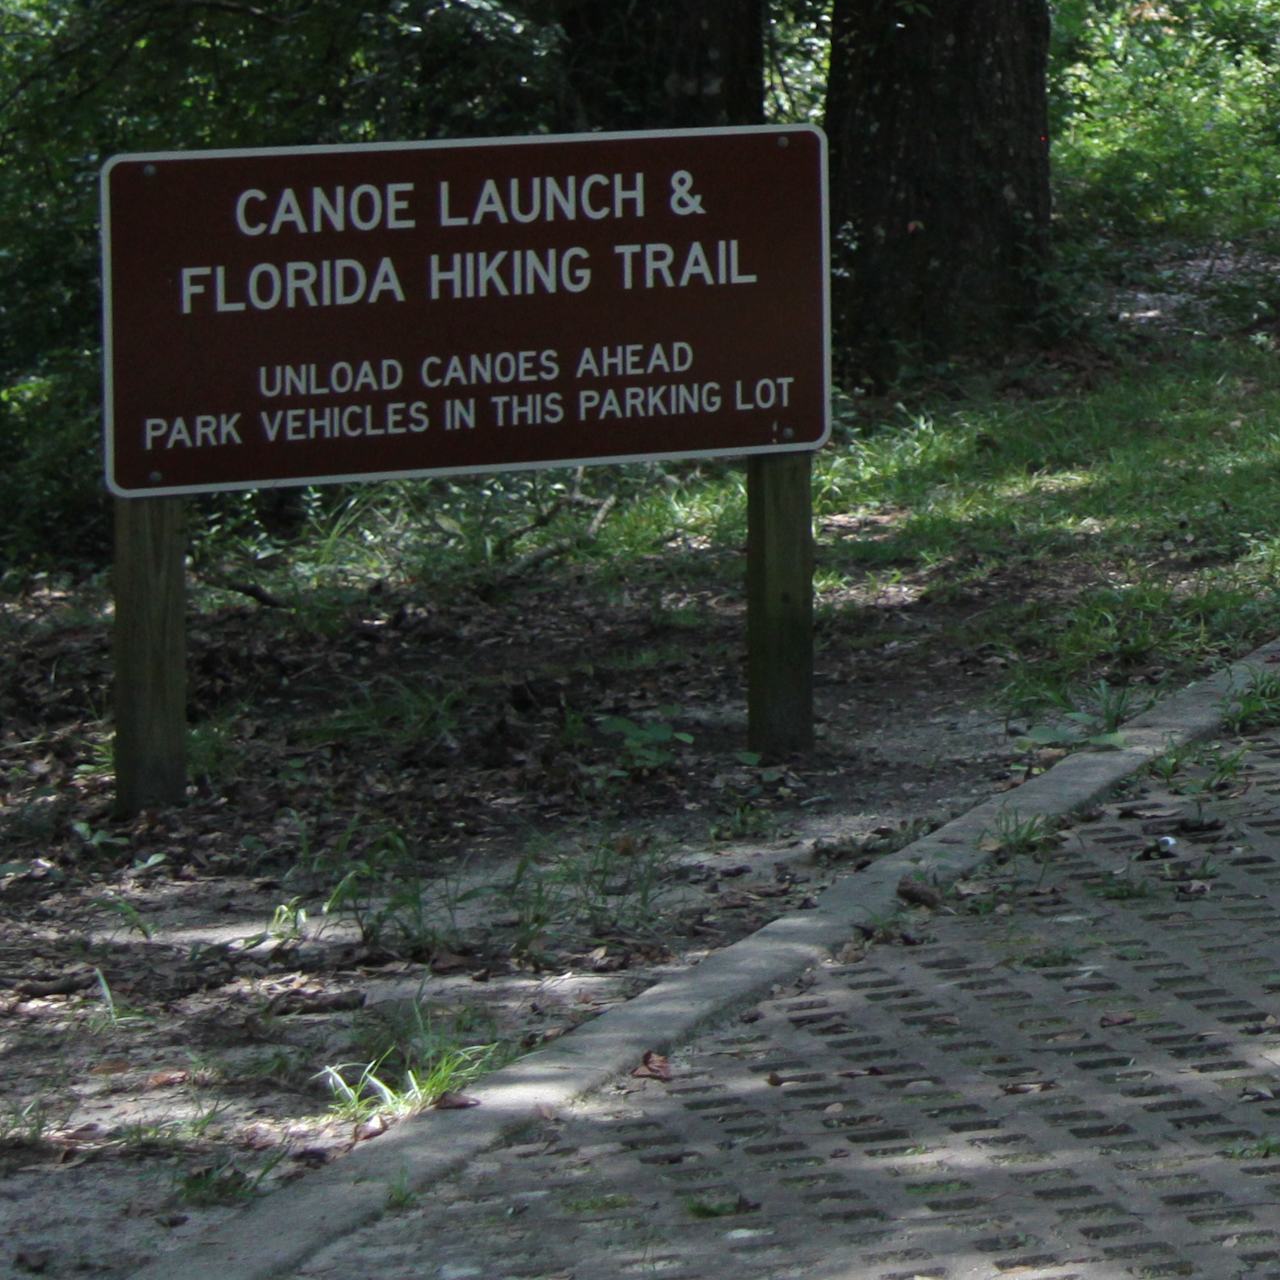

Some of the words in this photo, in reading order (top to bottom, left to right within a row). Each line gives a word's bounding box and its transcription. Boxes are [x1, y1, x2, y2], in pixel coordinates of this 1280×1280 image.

[236, 183, 415, 235] CANOE
[441, 173, 644, 226] LAUNCH
[671, 170, 705, 215] &
[182, 257, 404, 313] FLORIDA
[431, 247, 591, 299] HIKING
[615, 240, 757, 289] TRAIL
[260, 359, 402, 396] UNLOAD
[422, 350, 559, 387] CANOES
[576, 342, 693, 377] AHEAD
[146, 414, 241, 449] PARK
[261, 401, 428, 441] VEHICLES
[446, 399, 474, 429] IN
[492, 393, 563, 426] THIS
[580, 382, 721, 420] PARKING
[736, 377, 794, 410] LOT
